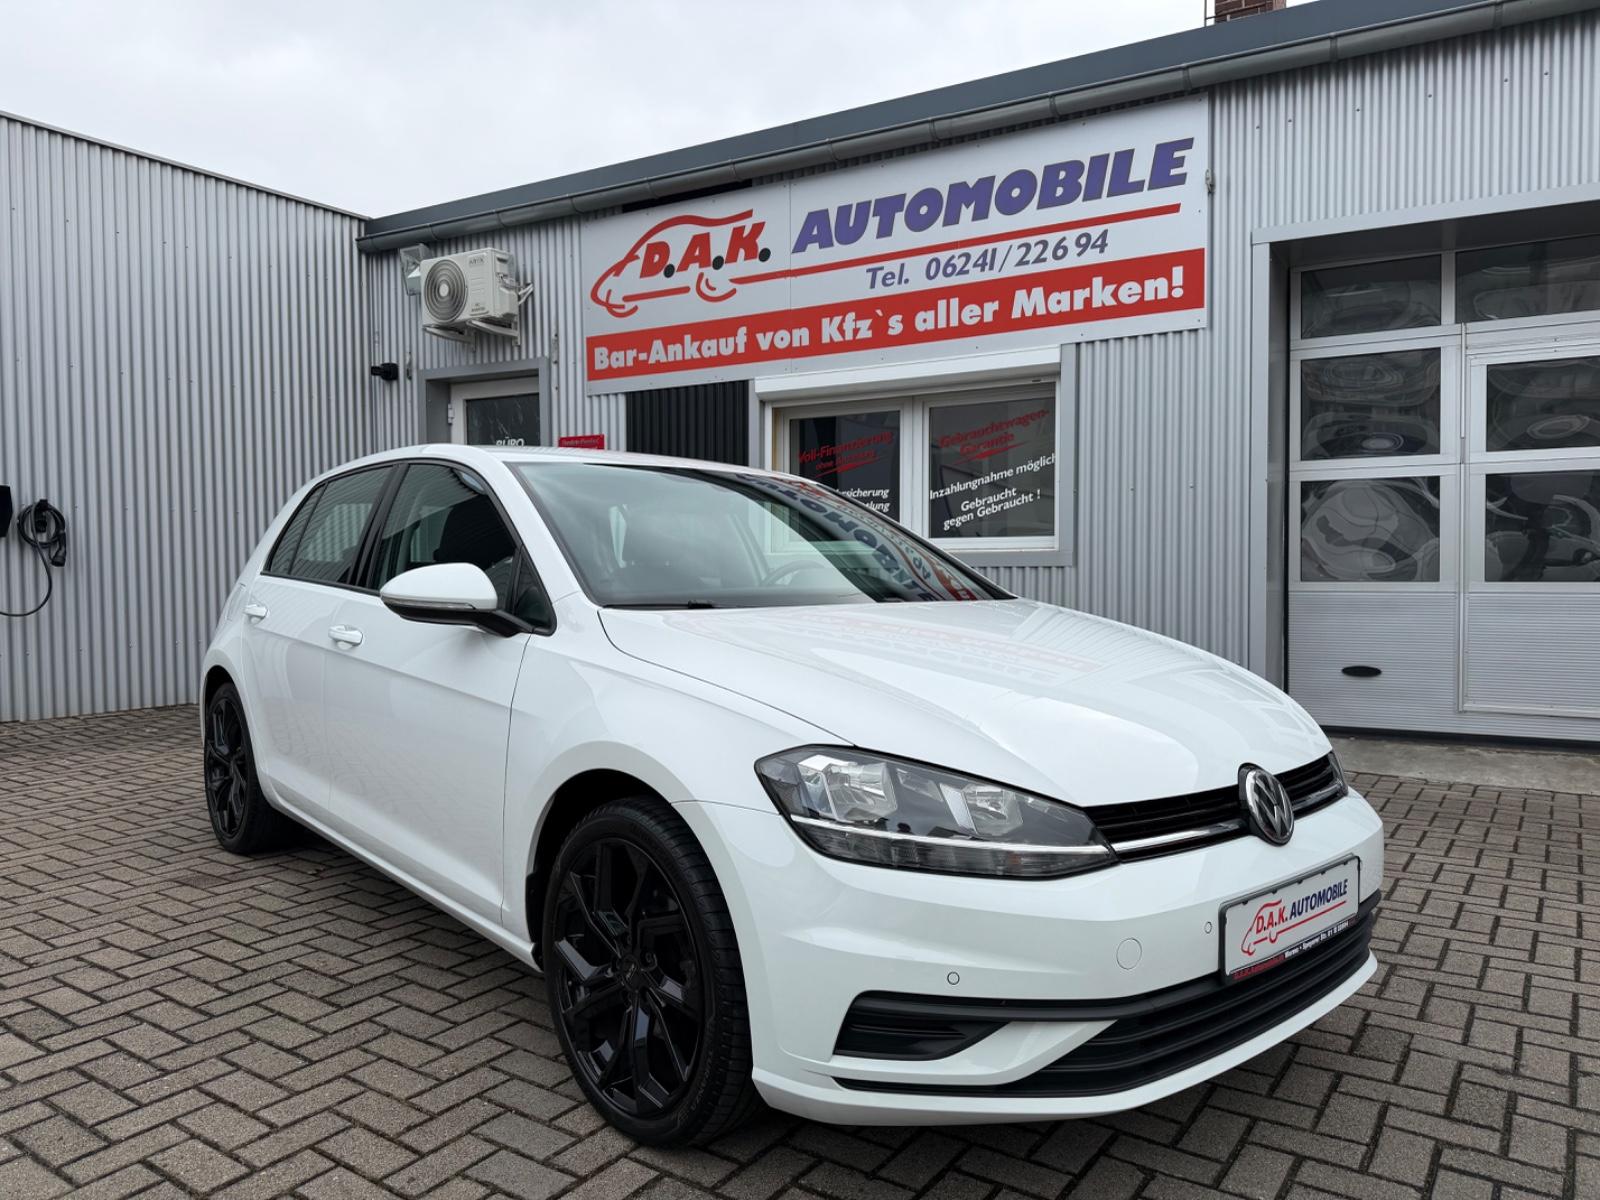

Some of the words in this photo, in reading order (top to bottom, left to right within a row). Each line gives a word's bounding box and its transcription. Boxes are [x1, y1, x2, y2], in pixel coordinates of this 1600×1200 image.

[640, 221, 772, 279] D.A.K.
[792, 137, 1194, 254] AUTOMOBILE
[866, 264, 910, 290] Tel.
[594, 327, 747, 370] Bar-Ankauf
[756, 321, 809, 350] von
[915, 297, 999, 332] aller
[1011, 265, 1184, 319] Marken!
[930, 467, 1014, 500] Inzahlungnahme
[961, 487, 1017, 512] Gebraucht
[943, 512, 974, 531] gegen
[977, 492, 1034, 517] Gebraucht
[1255, 906, 1288, 935] D.A.K.
[1290, 879, 1348, 920] AUTOMOBILE
